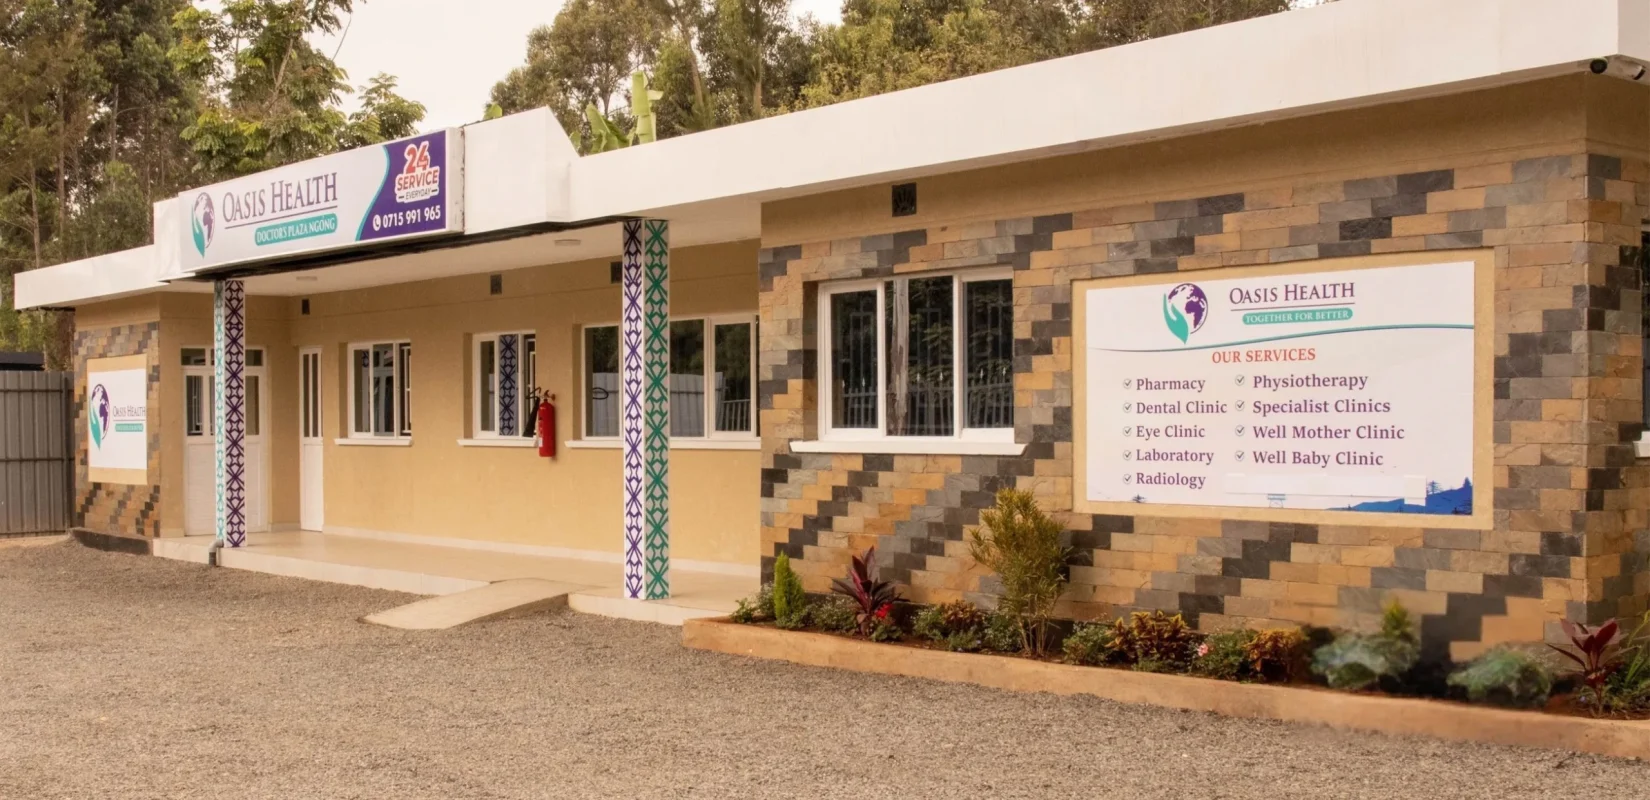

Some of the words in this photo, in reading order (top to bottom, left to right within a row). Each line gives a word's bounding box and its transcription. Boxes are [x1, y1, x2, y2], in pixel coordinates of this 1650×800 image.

[405, 144, 429, 174] 24
[397, 169, 439, 191] SERVICE
[222, 189, 265, 222] OASIS
[271, 172, 338, 213] HEALTH
[405, 188, 432, 200] EVERYDAY
[382, 212, 403, 228] 0715
[405, 209, 421, 224] 991
[424, 205, 441, 221] 965
[287, 223, 309, 237] PLAZA
[1229, 287, 1278, 305] OASIS
[1284, 282, 1355, 301] HEALTH
[1245, 312, 1293, 323] TOGETHER
[1295, 311, 1313, 321] FOR
[1315, 310, 1350, 320] BETTER
[1212, 350, 1242, 364] OUR
[1245, 348, 1316, 362] SERVICES
[1136, 378, 1206, 393] Pharmacy
[1253, 374, 1369, 392] Physiotherapy
[1136, 400, 1181, 414] Dental
[1185, 400, 1228, 414] Clinic
[1252, 399, 1330, 417] Specialist
[1334, 398, 1391, 413] Clinics
[1136, 425, 1160, 441] Eye
[1164, 424, 1206, 438] Clinic
[1253, 424, 1287, 439] Well
[1292, 424, 1351, 439] Mother
[1355, 424, 1405, 439] Clinic
[1136, 448, 1214, 466] Laboratory
[1253, 450, 1287, 464] Well
[1292, 450, 1331, 468] Baby
[1335, 451, 1384, 466] Clinic
[1136, 472, 1206, 489] Radiology
